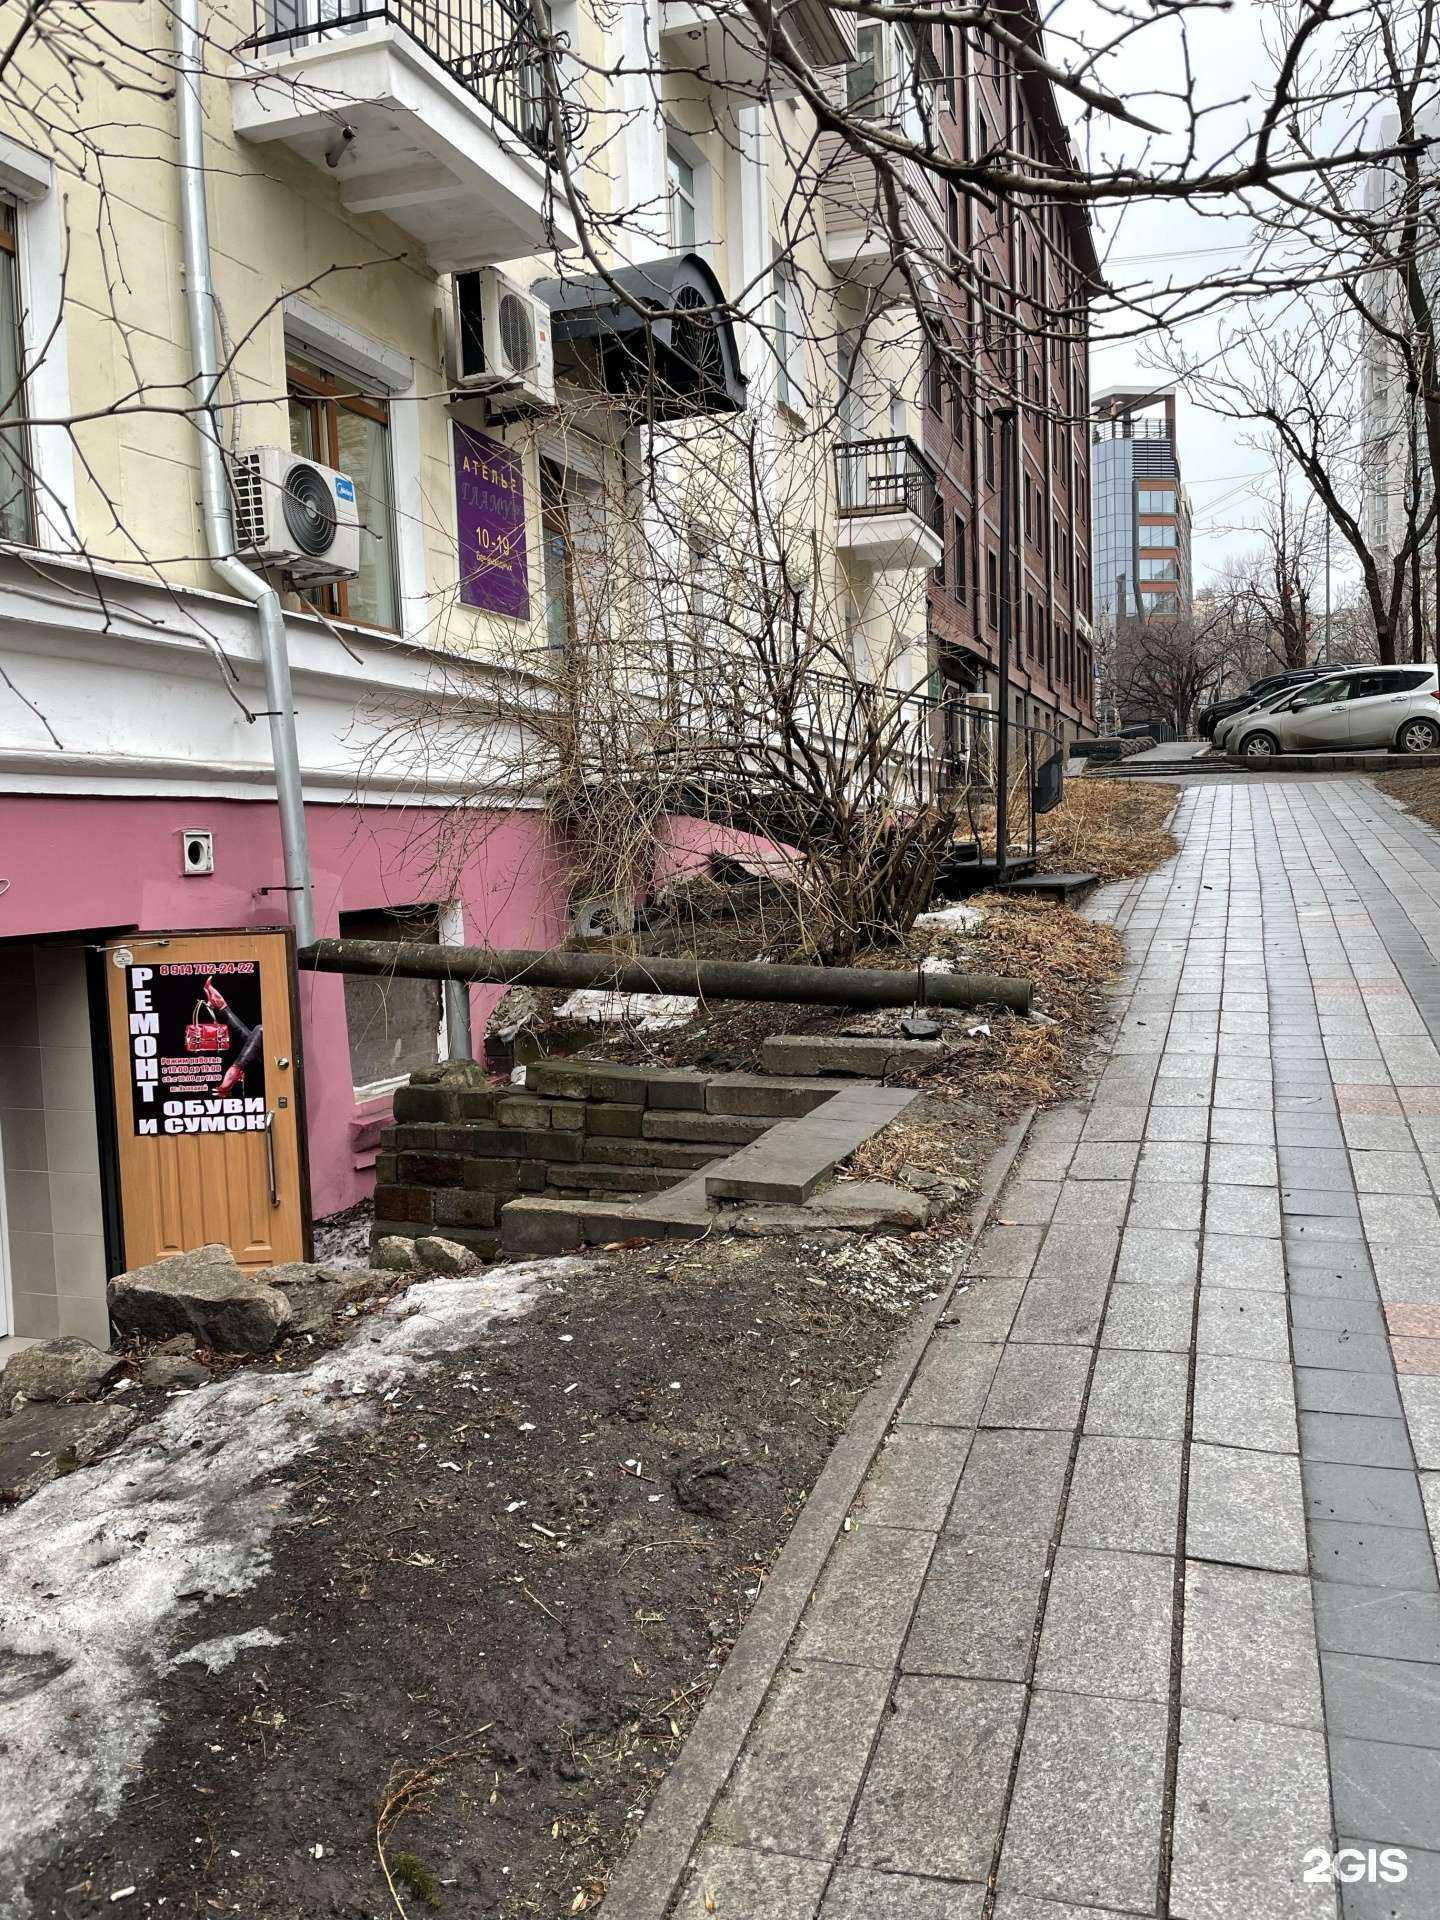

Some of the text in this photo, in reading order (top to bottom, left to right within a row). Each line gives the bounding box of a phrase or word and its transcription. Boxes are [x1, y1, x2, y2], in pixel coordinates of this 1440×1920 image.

[463, 455, 517, 492] АТЕЛЬЕ
[476, 526, 510, 556] 10-19
[160, 963, 254, 976] 8 914 702-24-22
[129, 967, 160, 1102] РЕМОНТ
[163, 1097, 265, 1116] ОБУВИ
[139, 1115, 265, 1135] И СУМОК
